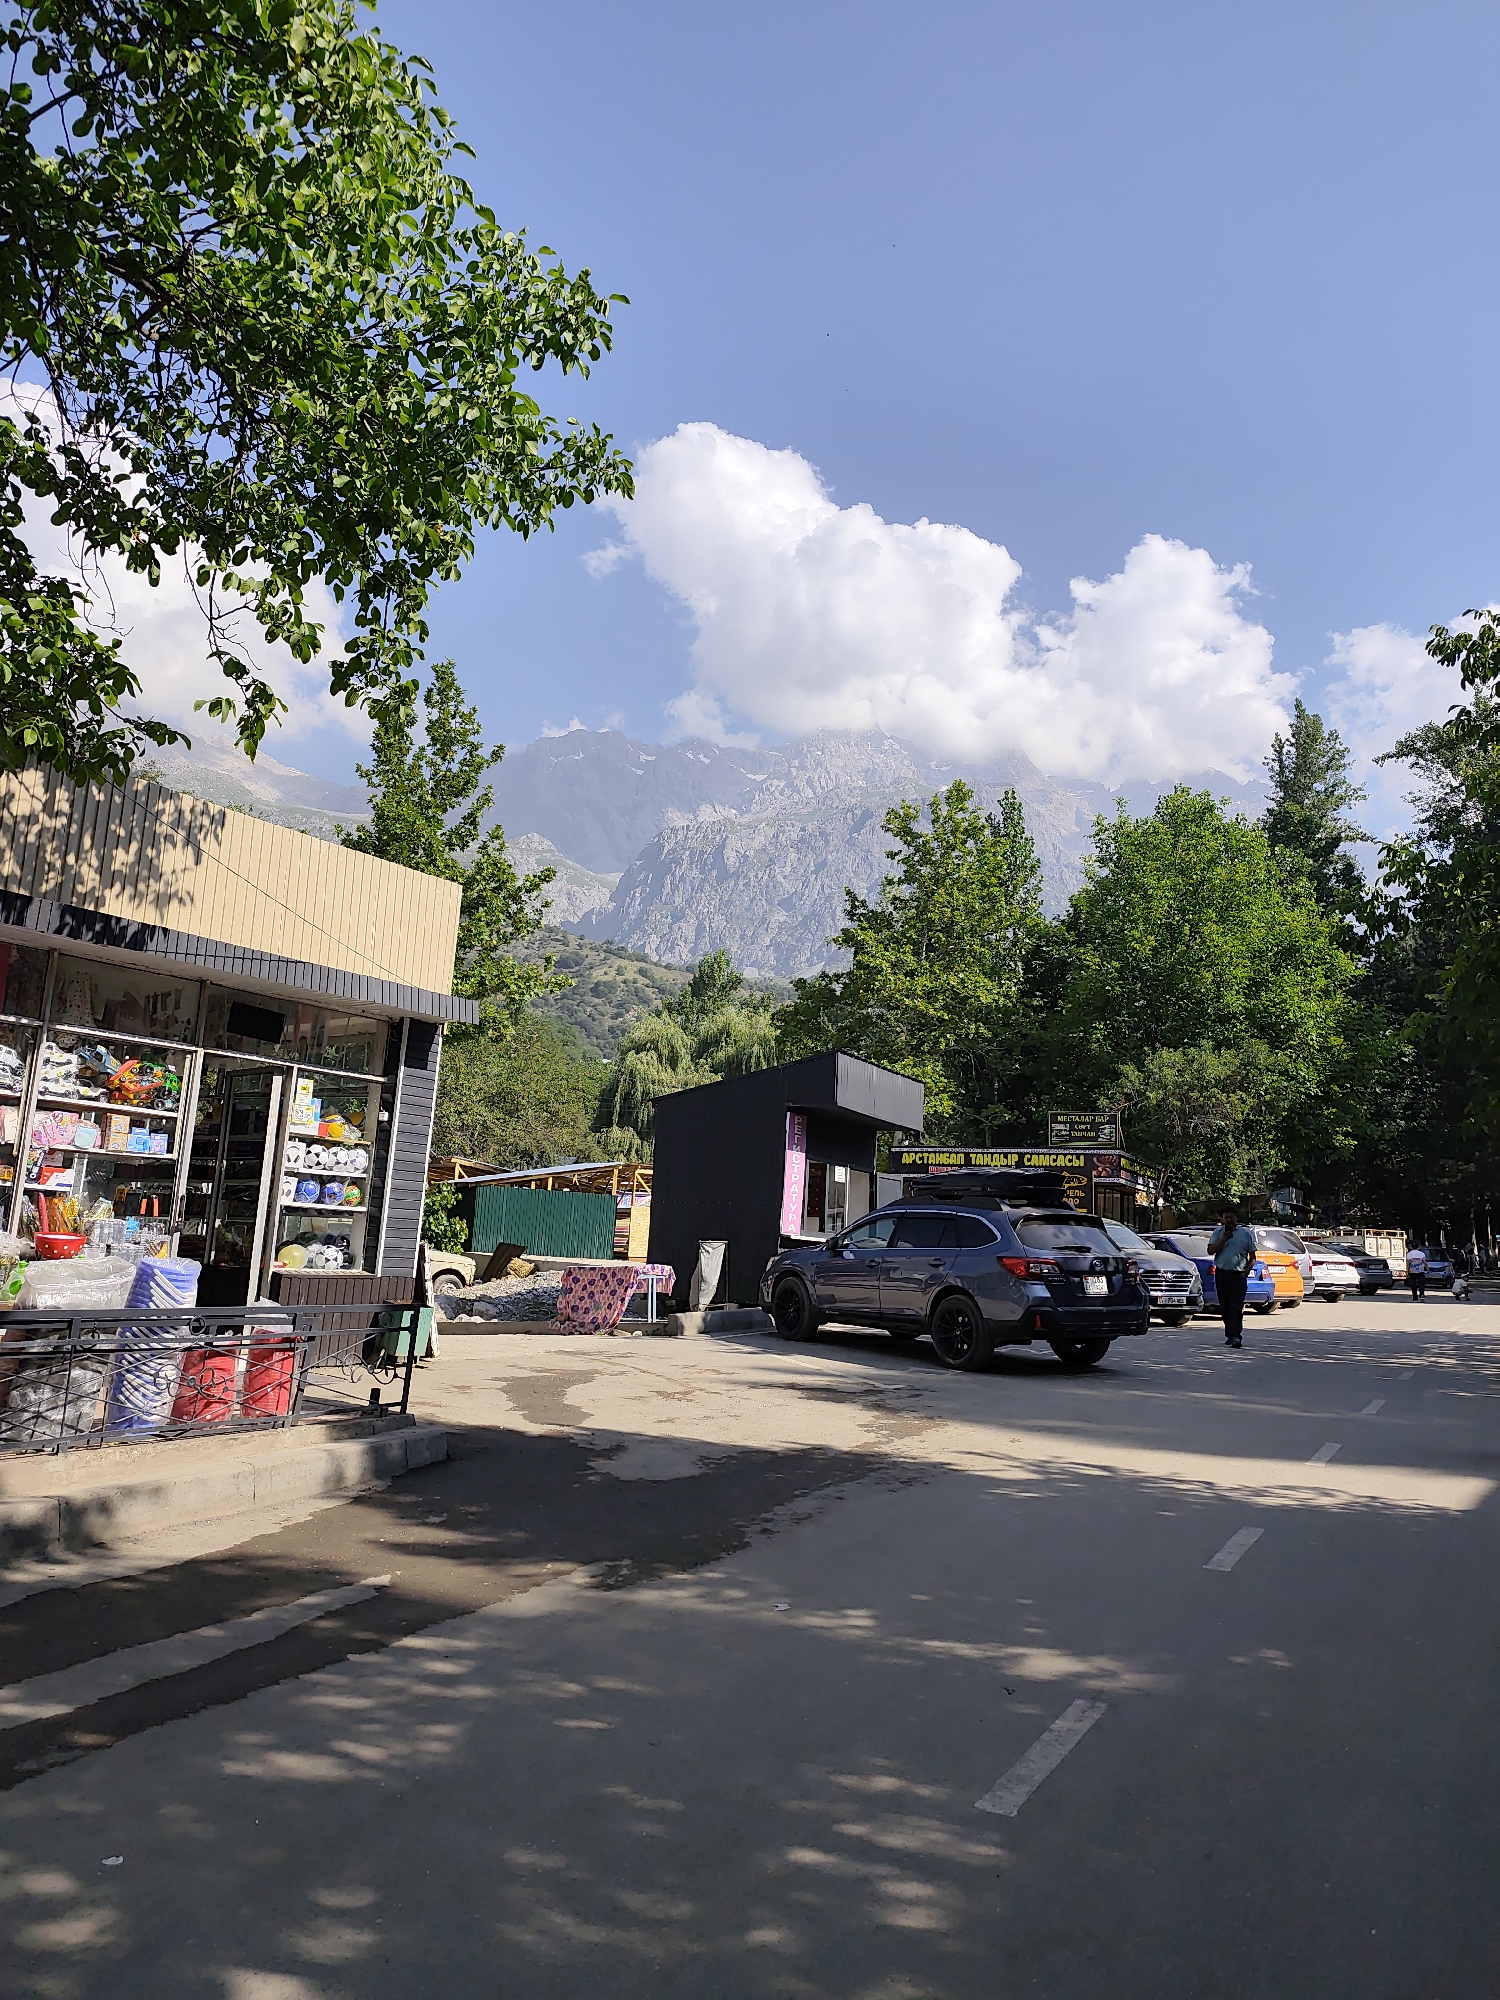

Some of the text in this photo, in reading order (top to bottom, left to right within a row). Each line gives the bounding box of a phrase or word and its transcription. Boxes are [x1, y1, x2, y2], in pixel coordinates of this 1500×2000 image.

[1057, 1115, 1110, 1123] МЕСТАЛАР БАР
[901, 1152, 1085, 1168] АРСТАНБАП ТАНДЫР САМСАСЫ
[786, 1115, 803, 1233] РЕГИСТРАТУРА
